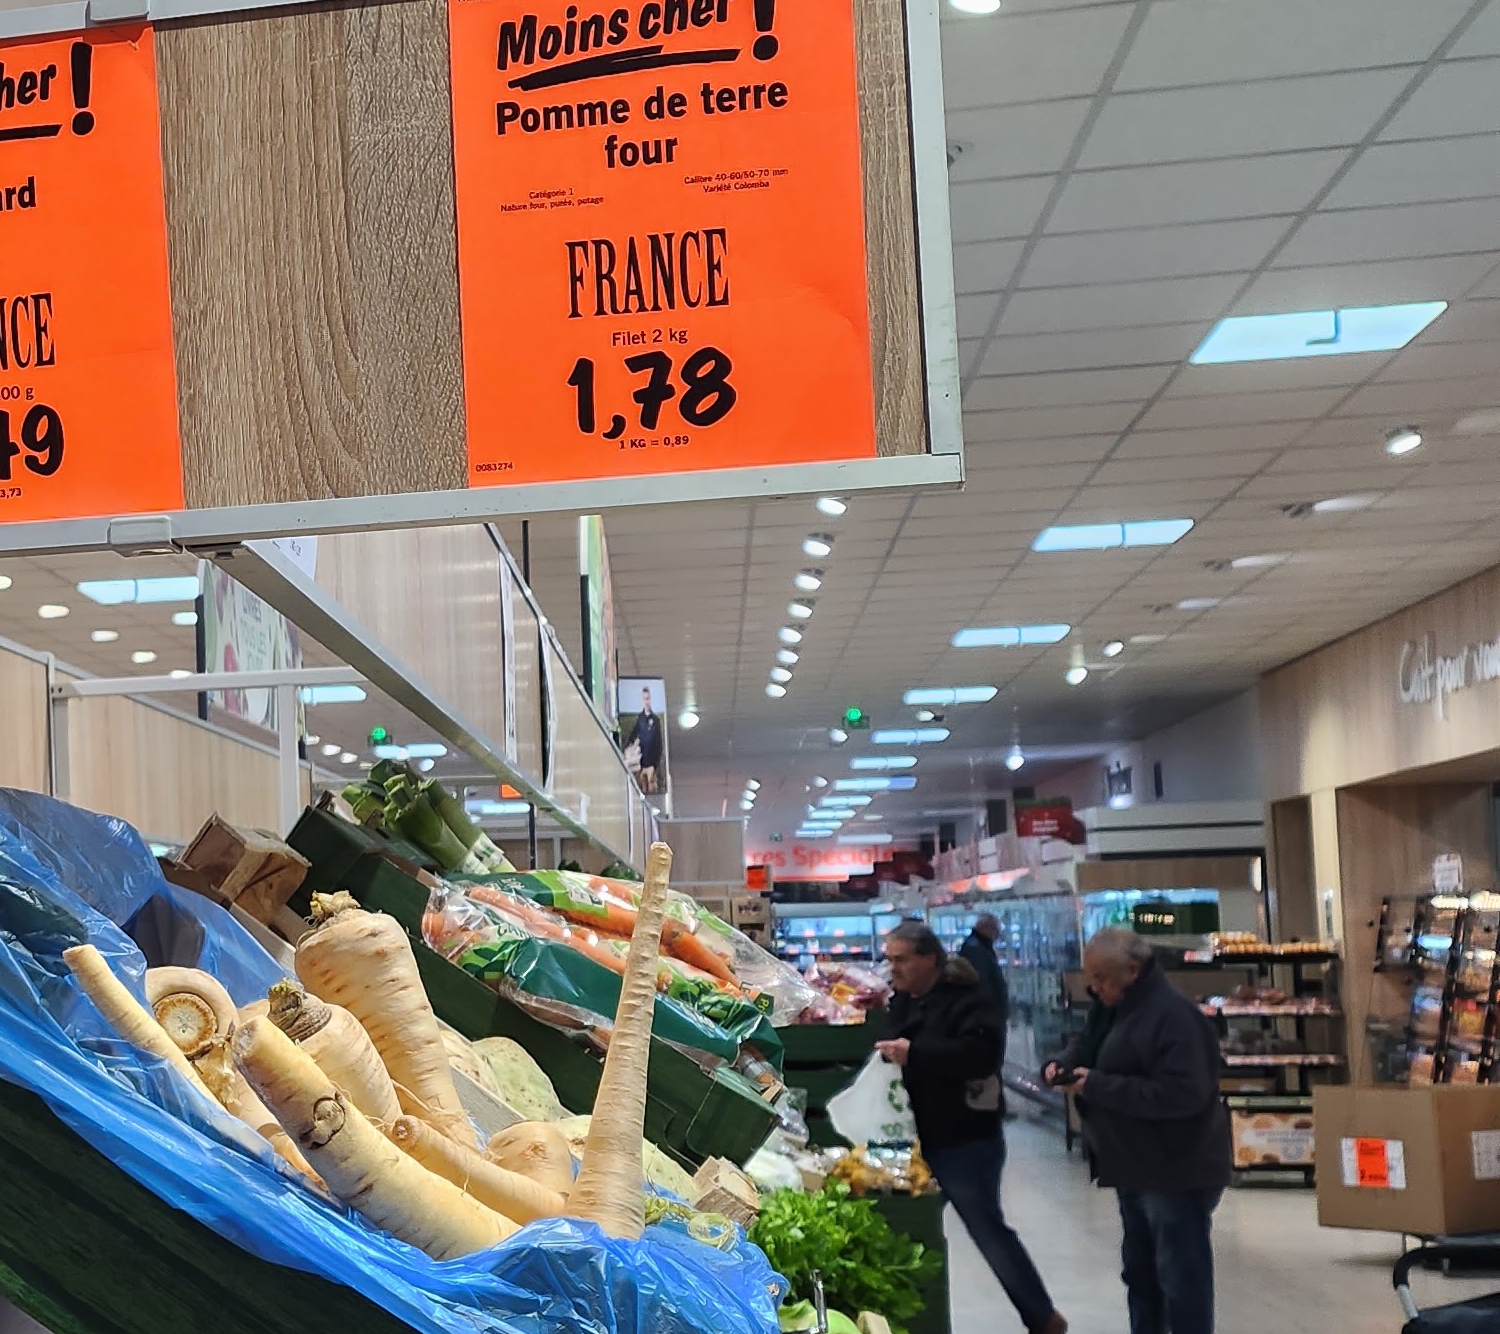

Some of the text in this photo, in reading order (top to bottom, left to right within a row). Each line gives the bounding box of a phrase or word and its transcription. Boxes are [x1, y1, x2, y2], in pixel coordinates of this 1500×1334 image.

[496, 5, 629, 71] Moins
[496, 80, 789, 136] Pomme de terre
[604, 134, 678, 169] four
[565, 228, 729, 319] FRANCE
[612, 328, 688, 347] Filet 2 kg
[25, 386, 35, 401] g
[567, 346, 737, 440] 1,78
[630, 438, 647, 448] KG
[663, 435, 689, 448] 0,89
[0, 487, 22, 500] 3,73
